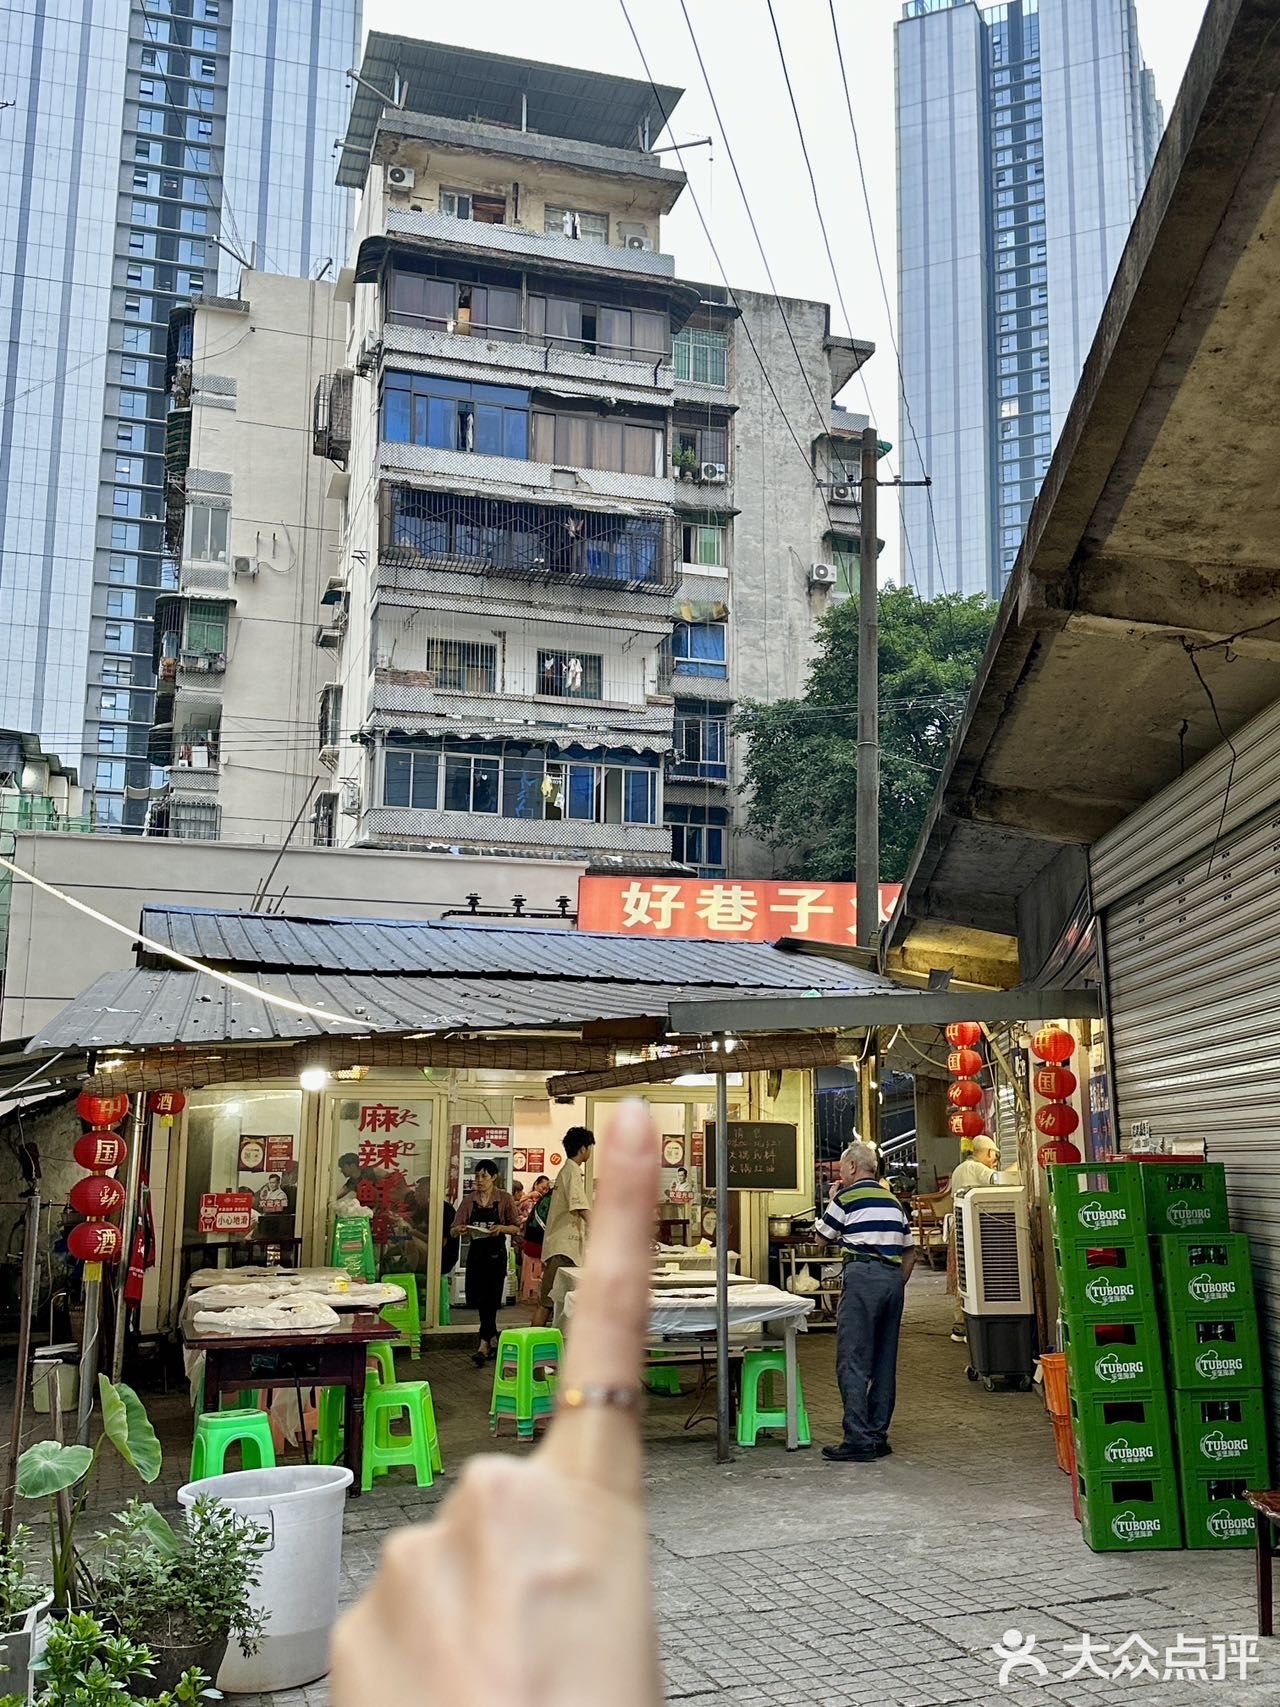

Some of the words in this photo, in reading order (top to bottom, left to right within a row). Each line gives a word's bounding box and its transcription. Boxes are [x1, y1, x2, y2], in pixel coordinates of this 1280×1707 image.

[157, 1093, 173, 1110] 酒
[218, 1215, 248, 1226] 小心地滑
[1084, 1208, 1126, 1222] TUBORG
[1172, 1208, 1211, 1221] TUBORG
[1091, 1284, 1134, 1298] TUBORG
[1194, 1281, 1235, 1295] TUBORG
[1101, 1361, 1143, 1375] TUBORG
[1201, 1358, 1242, 1372] TUBORG
[1206, 1438, 1248, 1452] TUBORG
[1111, 1446, 1153, 1460] TUBORG
[1119, 1519, 1160, 1533] TUBORG
[1214, 1517, 1255, 1530] TUBORG
